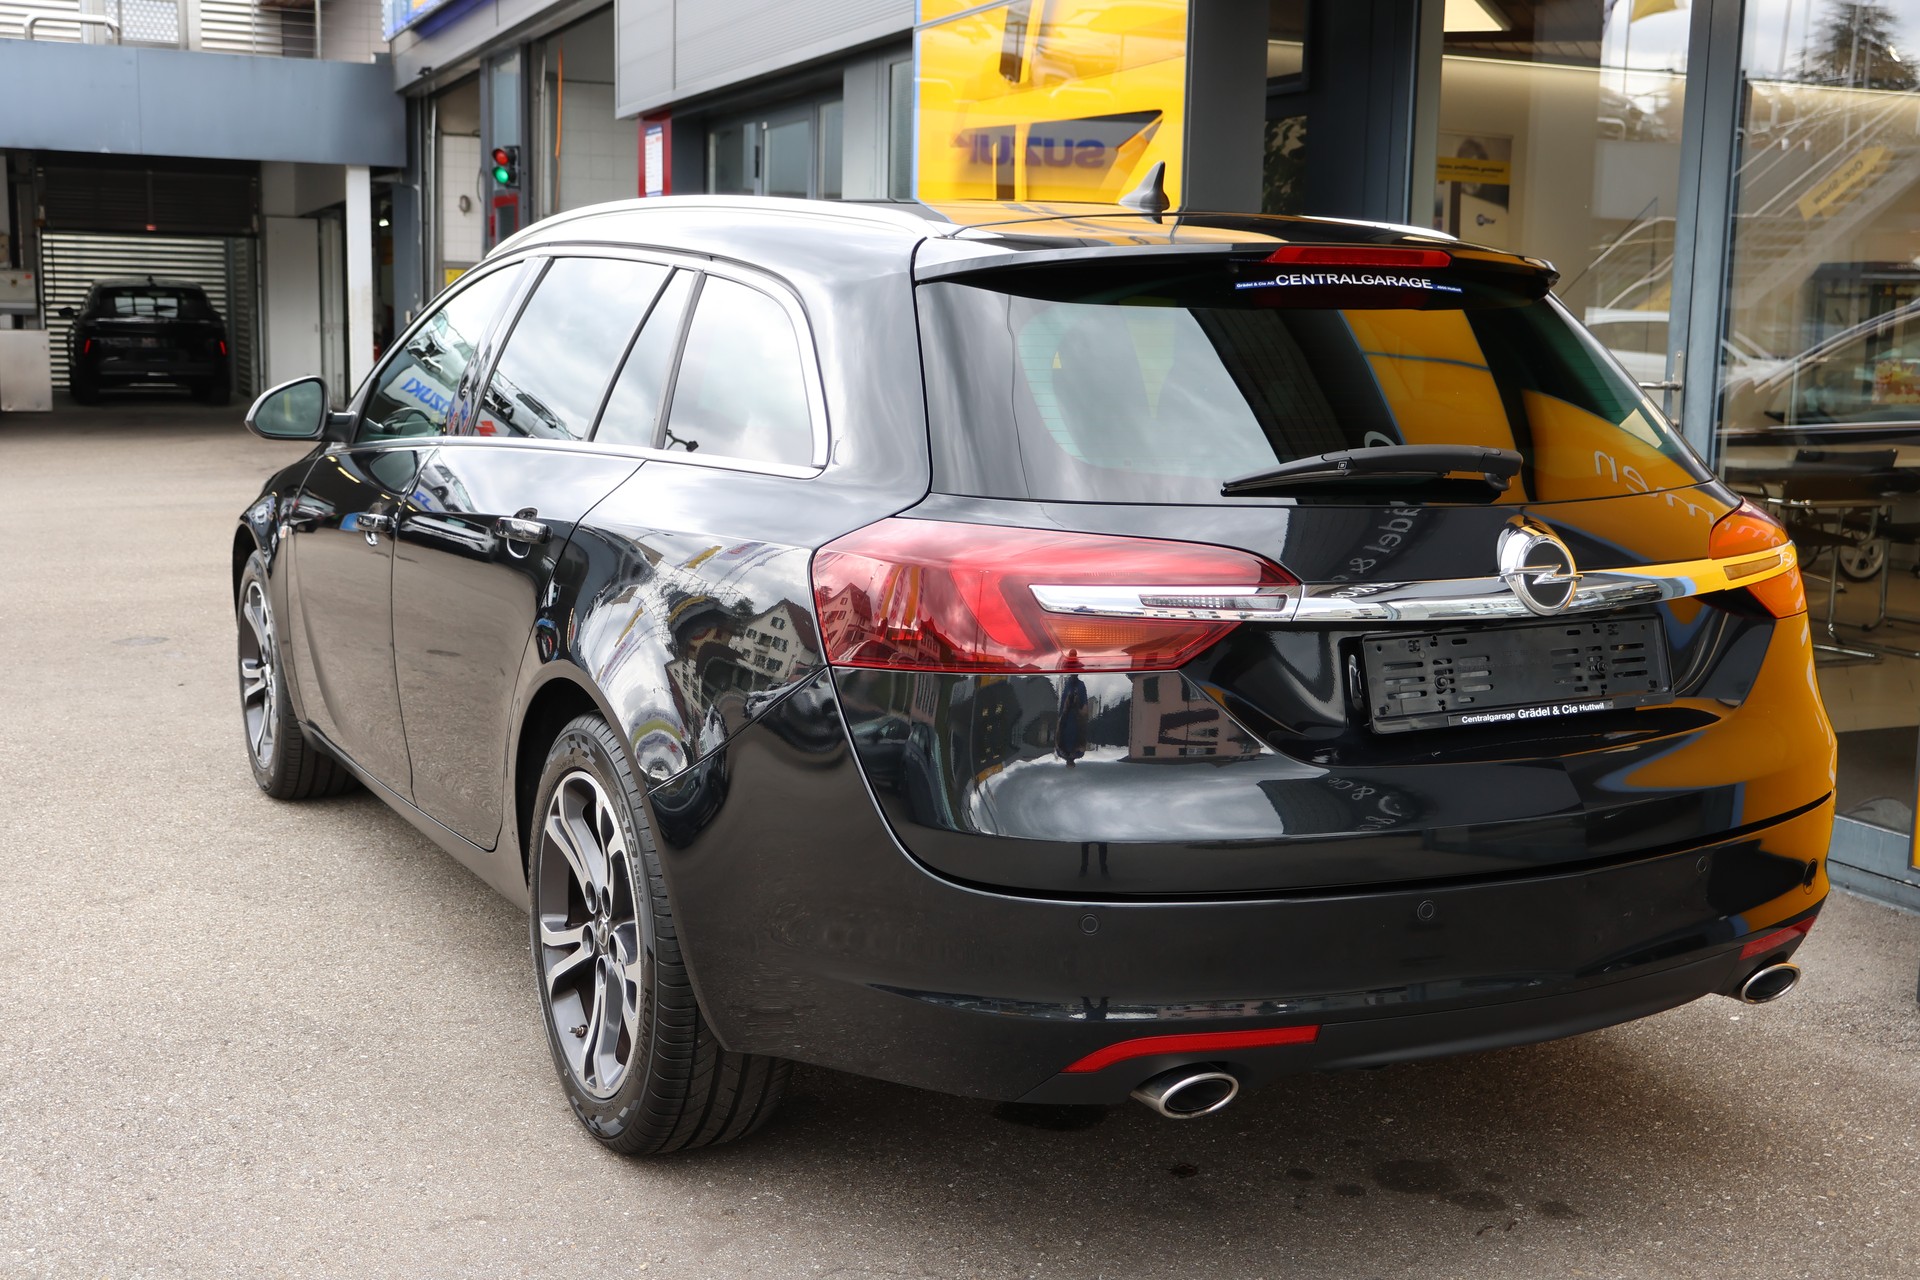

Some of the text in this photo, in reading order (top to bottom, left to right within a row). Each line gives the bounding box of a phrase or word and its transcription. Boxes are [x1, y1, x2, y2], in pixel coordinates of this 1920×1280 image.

[1275, 273, 1433, 289] CENTRALGARAGE
[1461, 702, 1605, 724] Centralgarage Grädel & Cie Huttwil
